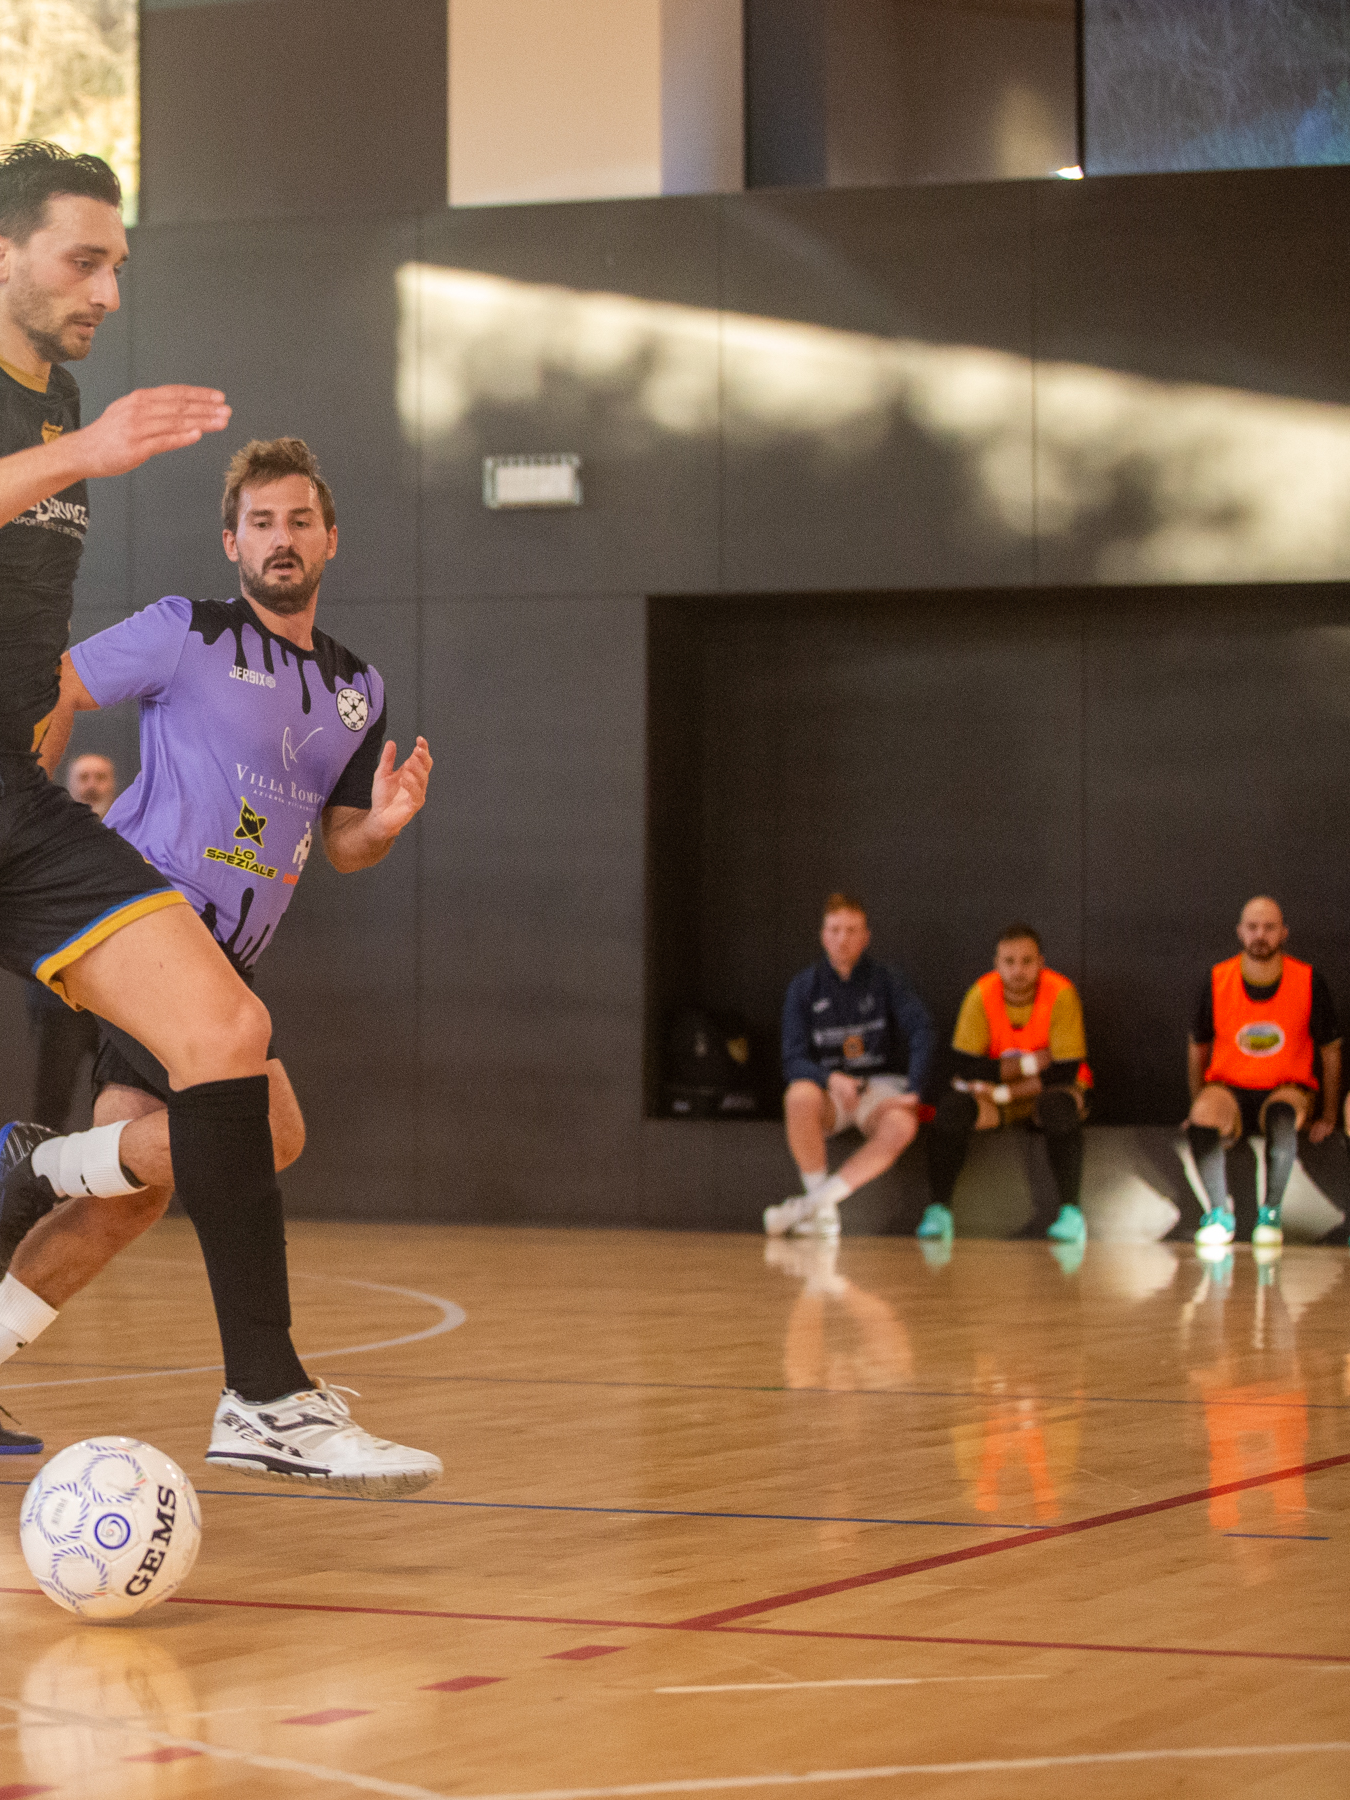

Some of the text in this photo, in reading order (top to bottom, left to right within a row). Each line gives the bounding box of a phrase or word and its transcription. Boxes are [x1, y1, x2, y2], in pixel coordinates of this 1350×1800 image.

[229, 664, 266, 686] JERSIX
[236, 763, 284, 795] VILLA
[205, 848, 277, 879] SPEZIALE
[233, 846, 256, 860] LO
[123, 1484, 177, 1597] GEMS
